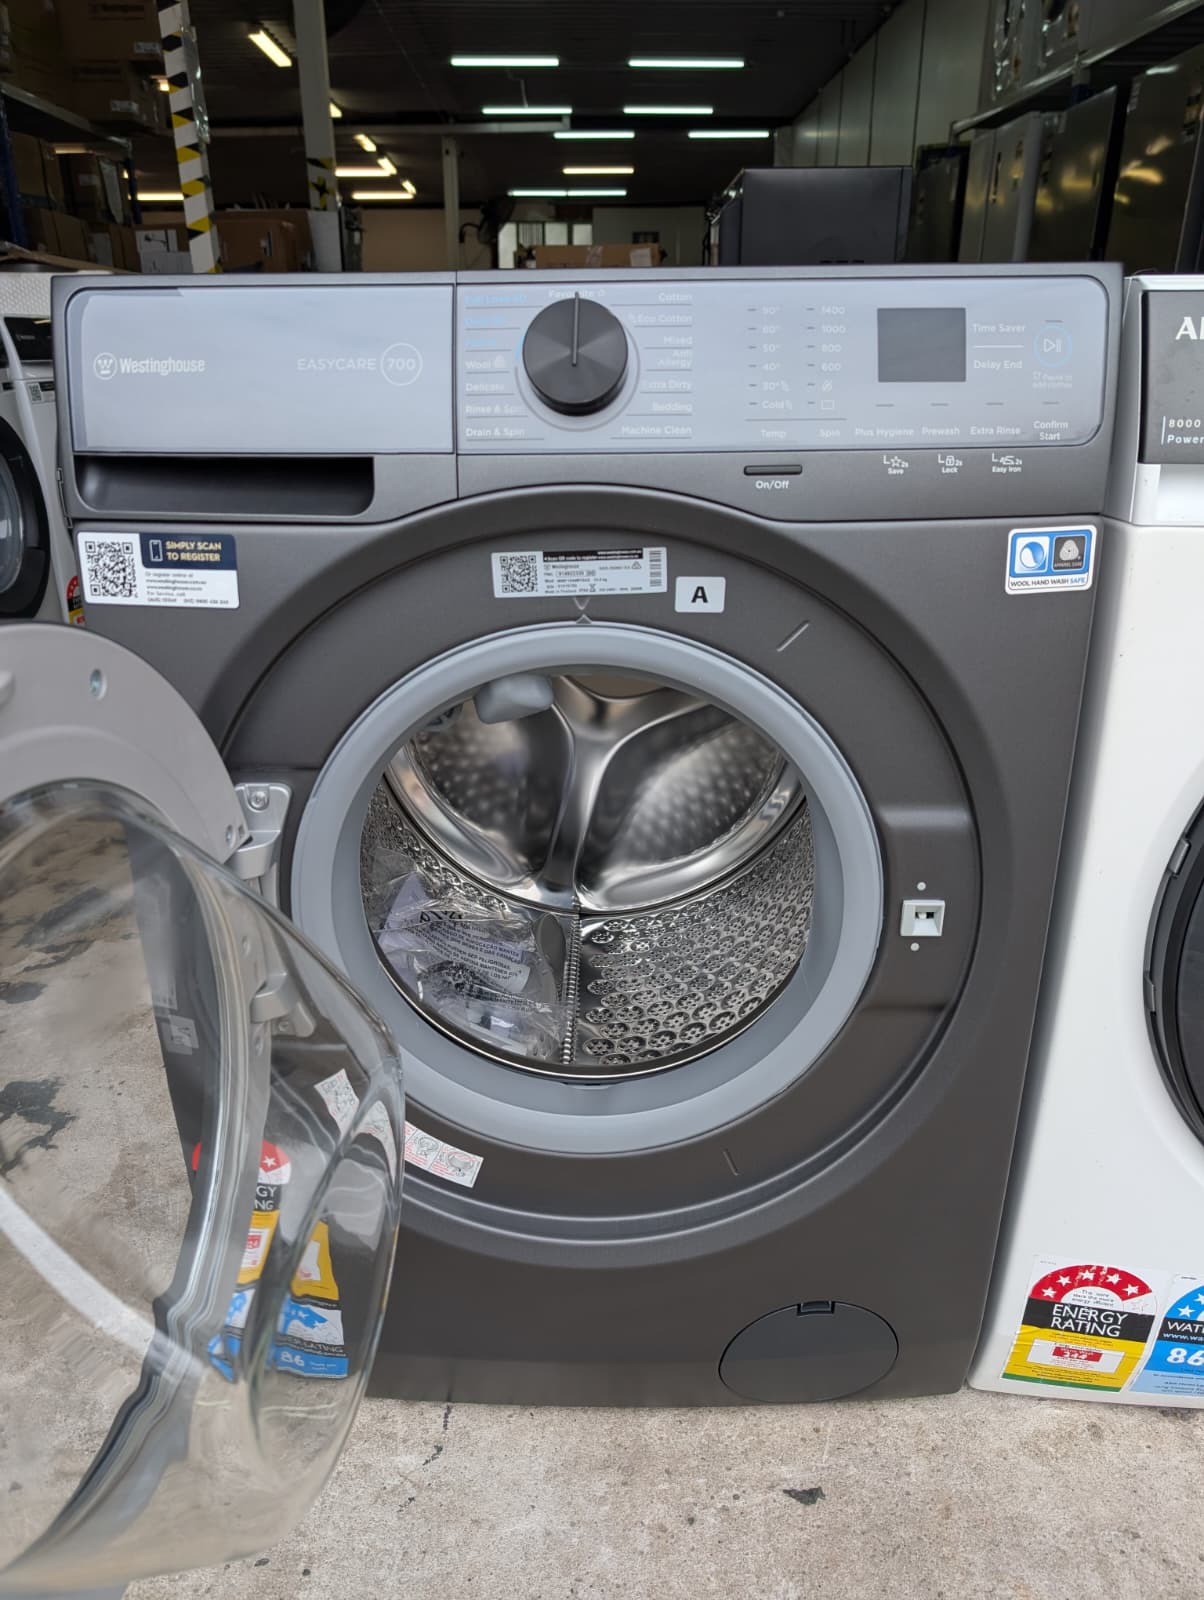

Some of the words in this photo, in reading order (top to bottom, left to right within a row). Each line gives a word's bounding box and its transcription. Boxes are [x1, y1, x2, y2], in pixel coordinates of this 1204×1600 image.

[658, 293, 692, 302] Cotton
[821, 306, 846, 314] 1400
[658, 314, 692, 323] Cotton
[821, 325, 846, 334] 1000
[973, 324, 996, 333] Time
[999, 324, 1026, 333] Saver
[1175, 316, 1204, 340] A
[663, 336, 692, 345] Mixed
[821, 344, 842, 353] 800
[119, 357, 205, 376] Westinghouse
[297, 358, 377, 371] EASYCARE
[386, 358, 417, 371] 700
[465, 360, 491, 369] Wool
[821, 363, 842, 371] 600
[973, 360, 1001, 371] Delay
[1003, 360, 1023, 369] End
[465, 383, 504, 392] Delicate
[465, 405, 492, 414] Rinse
[652, 401, 692, 412] Bedding
[761, 400, 785, 409] Cold
[1033, 420, 1069, 429] Confirm
[1168, 418, 1202, 429] 8000
[465, 427, 492, 437] Drain
[494, 427, 502, 437] &
[504, 427, 526, 439] Spin
[622, 425, 661, 434] Machine
[664, 425, 692, 434] Clean
[761, 429, 787, 439] Temp
[819, 429, 841, 438] Spin
[855, 427, 874, 437] Plus
[876, 427, 915, 438] Hygiene
[922, 426, 960, 436] Prewash
[970, 426, 994, 435] Extra
[997, 426, 1021, 435] Rinse
[1039, 431, 1061, 441] Start
[992, 466, 1007, 474] Easy
[755, 480, 790, 490] On/Off
[166, 541, 196, 551] SIMPLY
[197, 541, 222, 550] SCAN
[167, 552, 179, 561] TO
[180, 552, 221, 562] REGISTER
[691, 586, 708, 604] A
[1052, 1304, 1128, 1325] ENERGY
[1051, 1317, 1121, 1337] RATING
[1168, 1320, 1204, 1334] WAT
[1167, 1347, 1204, 1366] 86
